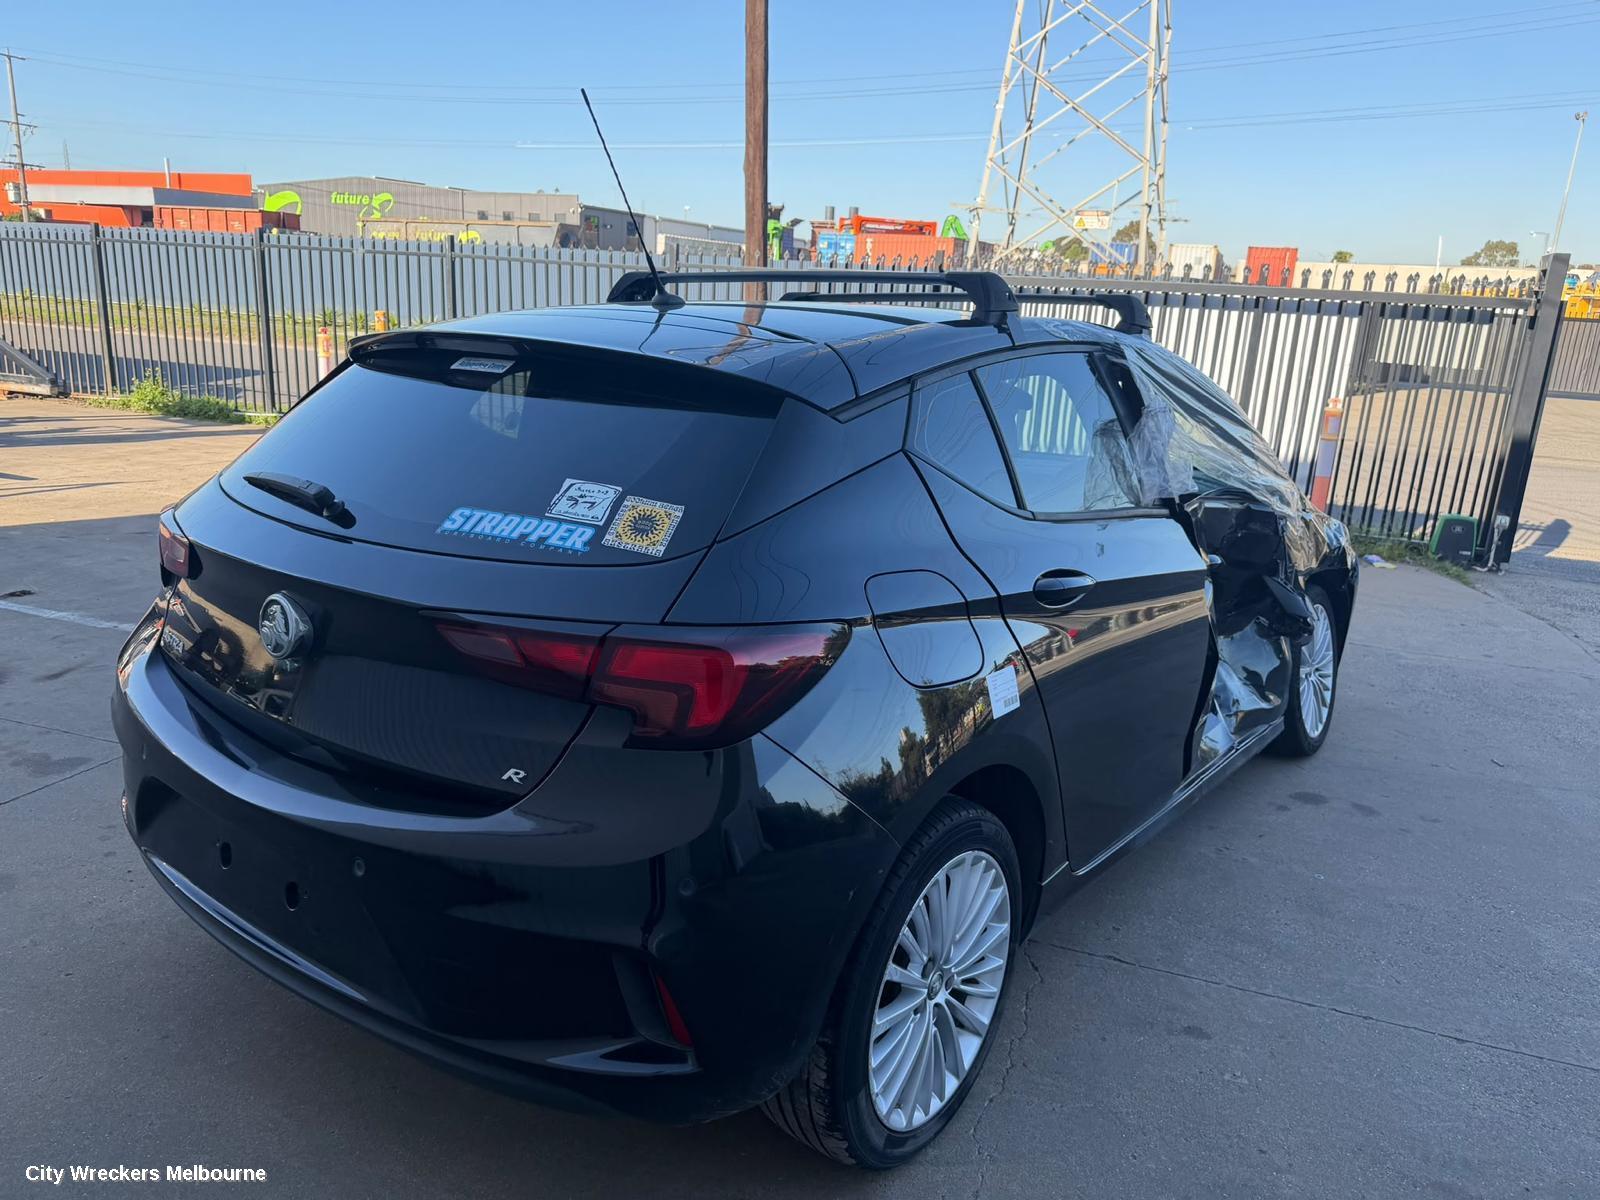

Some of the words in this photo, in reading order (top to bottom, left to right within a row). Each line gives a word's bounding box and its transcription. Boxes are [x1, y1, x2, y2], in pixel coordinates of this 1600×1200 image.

[331, 191, 370, 205] future
[441, 507, 596, 552] STRAPPER
[501, 768, 527, 784] R
